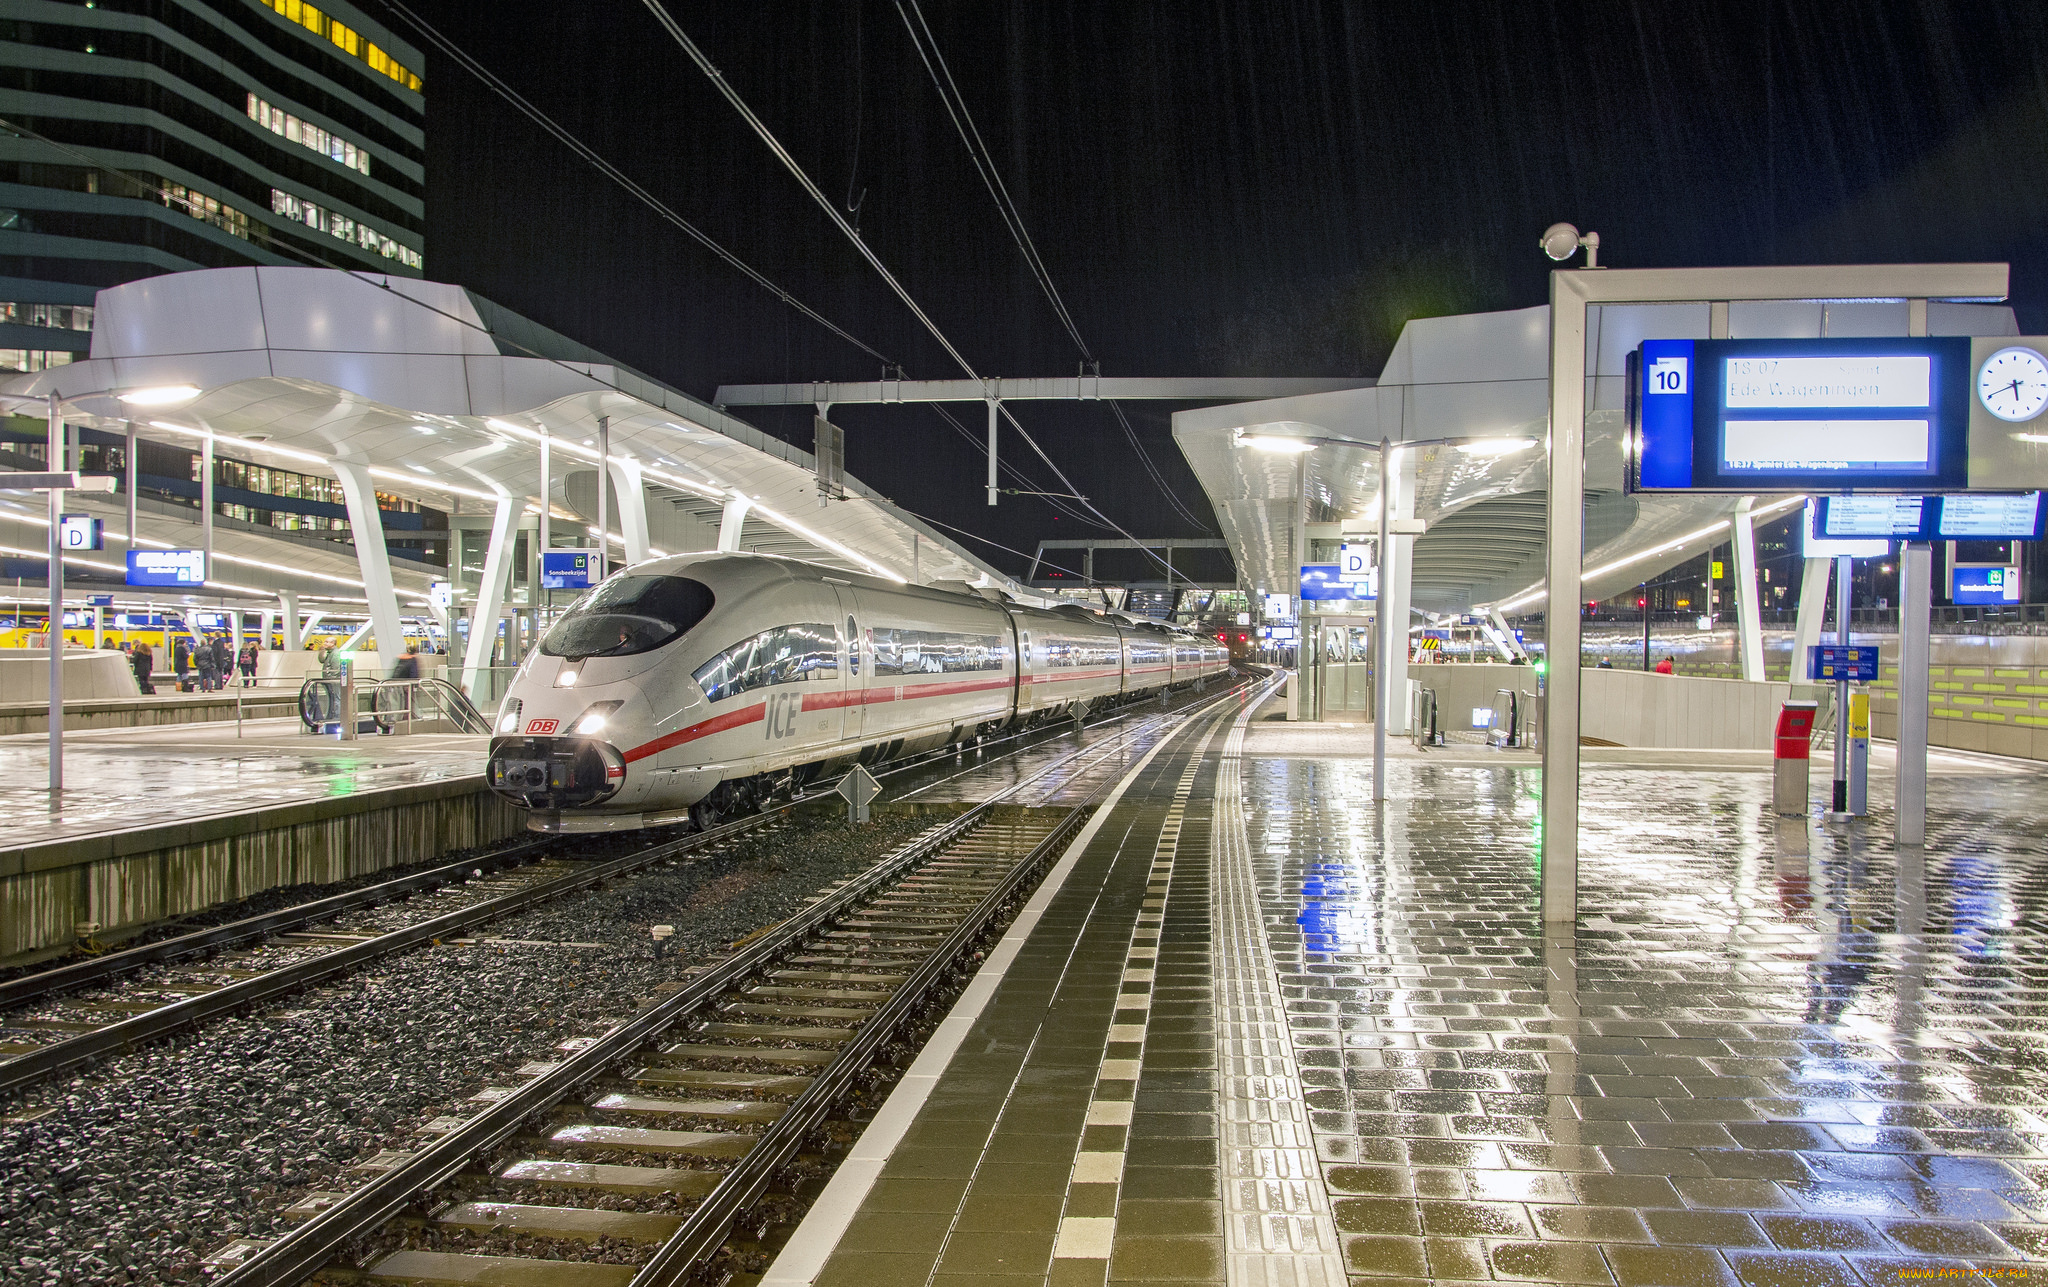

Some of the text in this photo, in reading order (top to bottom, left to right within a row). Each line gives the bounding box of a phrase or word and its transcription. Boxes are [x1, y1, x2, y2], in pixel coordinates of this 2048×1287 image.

[1656, 371, 1681, 390] 10
[70, 529, 83, 546] D
[1349, 555, 1363, 571] D
[548, 569, 587, 577] Sonsbeekzijde
[765, 691, 801, 741] ICE
[529, 721, 555, 732] DB
